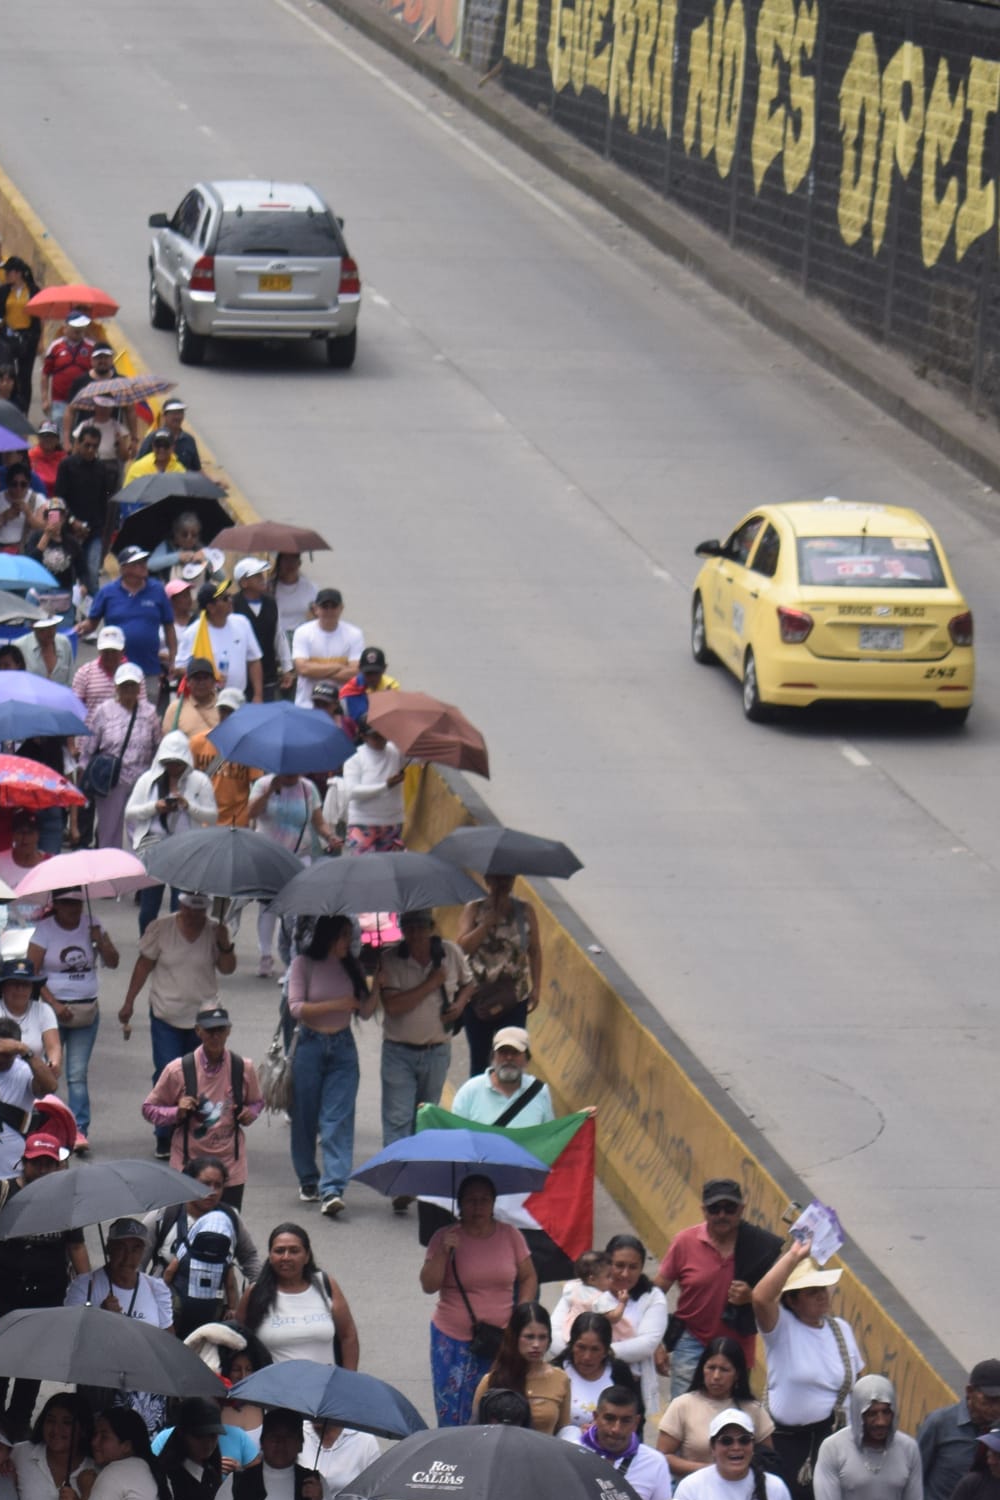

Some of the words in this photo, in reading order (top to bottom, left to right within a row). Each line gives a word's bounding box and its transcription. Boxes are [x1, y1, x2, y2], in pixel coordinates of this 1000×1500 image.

[683, 0, 746, 179] NO
[751, 0, 819, 197] ES
[836, 31, 1000, 269] OPCI
[837, 605, 873, 617] SERVICIO
